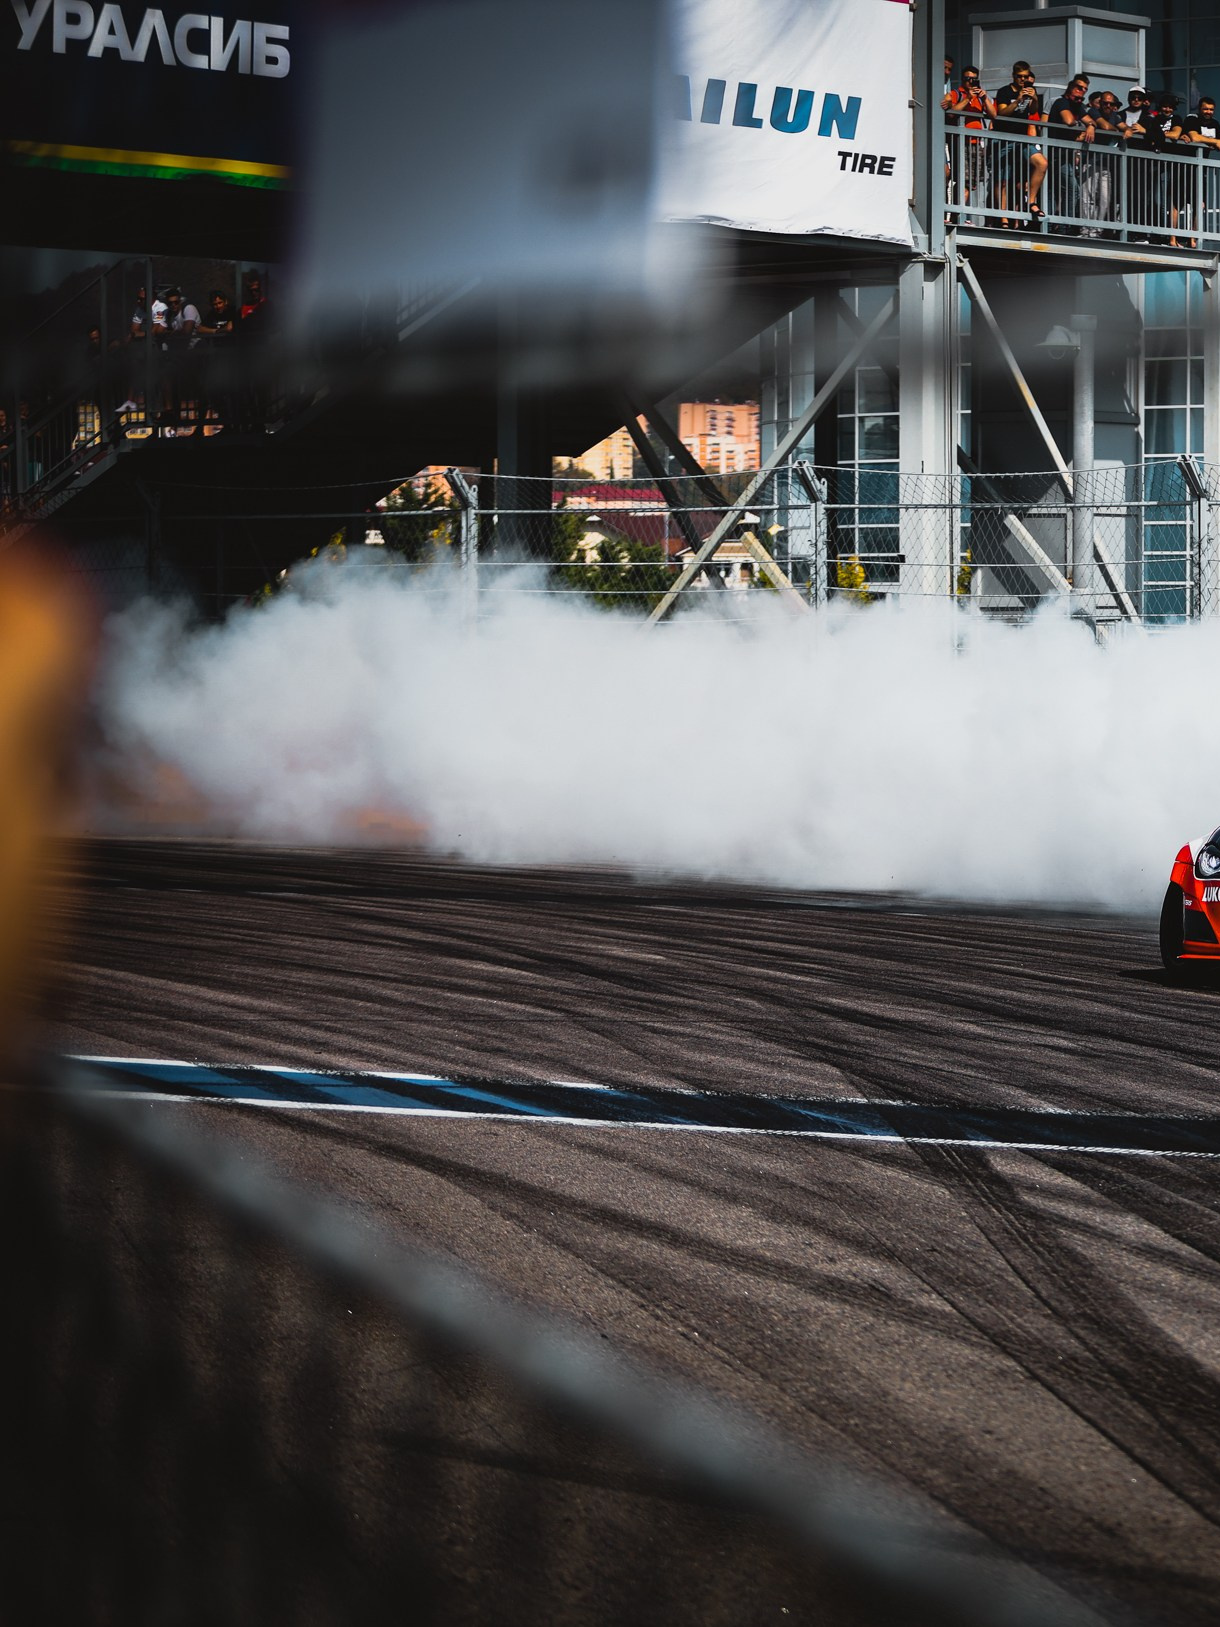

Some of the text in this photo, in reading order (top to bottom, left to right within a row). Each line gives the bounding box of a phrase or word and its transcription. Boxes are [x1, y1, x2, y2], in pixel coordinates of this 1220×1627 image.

[10, 0, 291, 79] УРАЛСИБ
[673, 74, 862, 140] ILUN
[837, 150, 896, 176] TIRE
